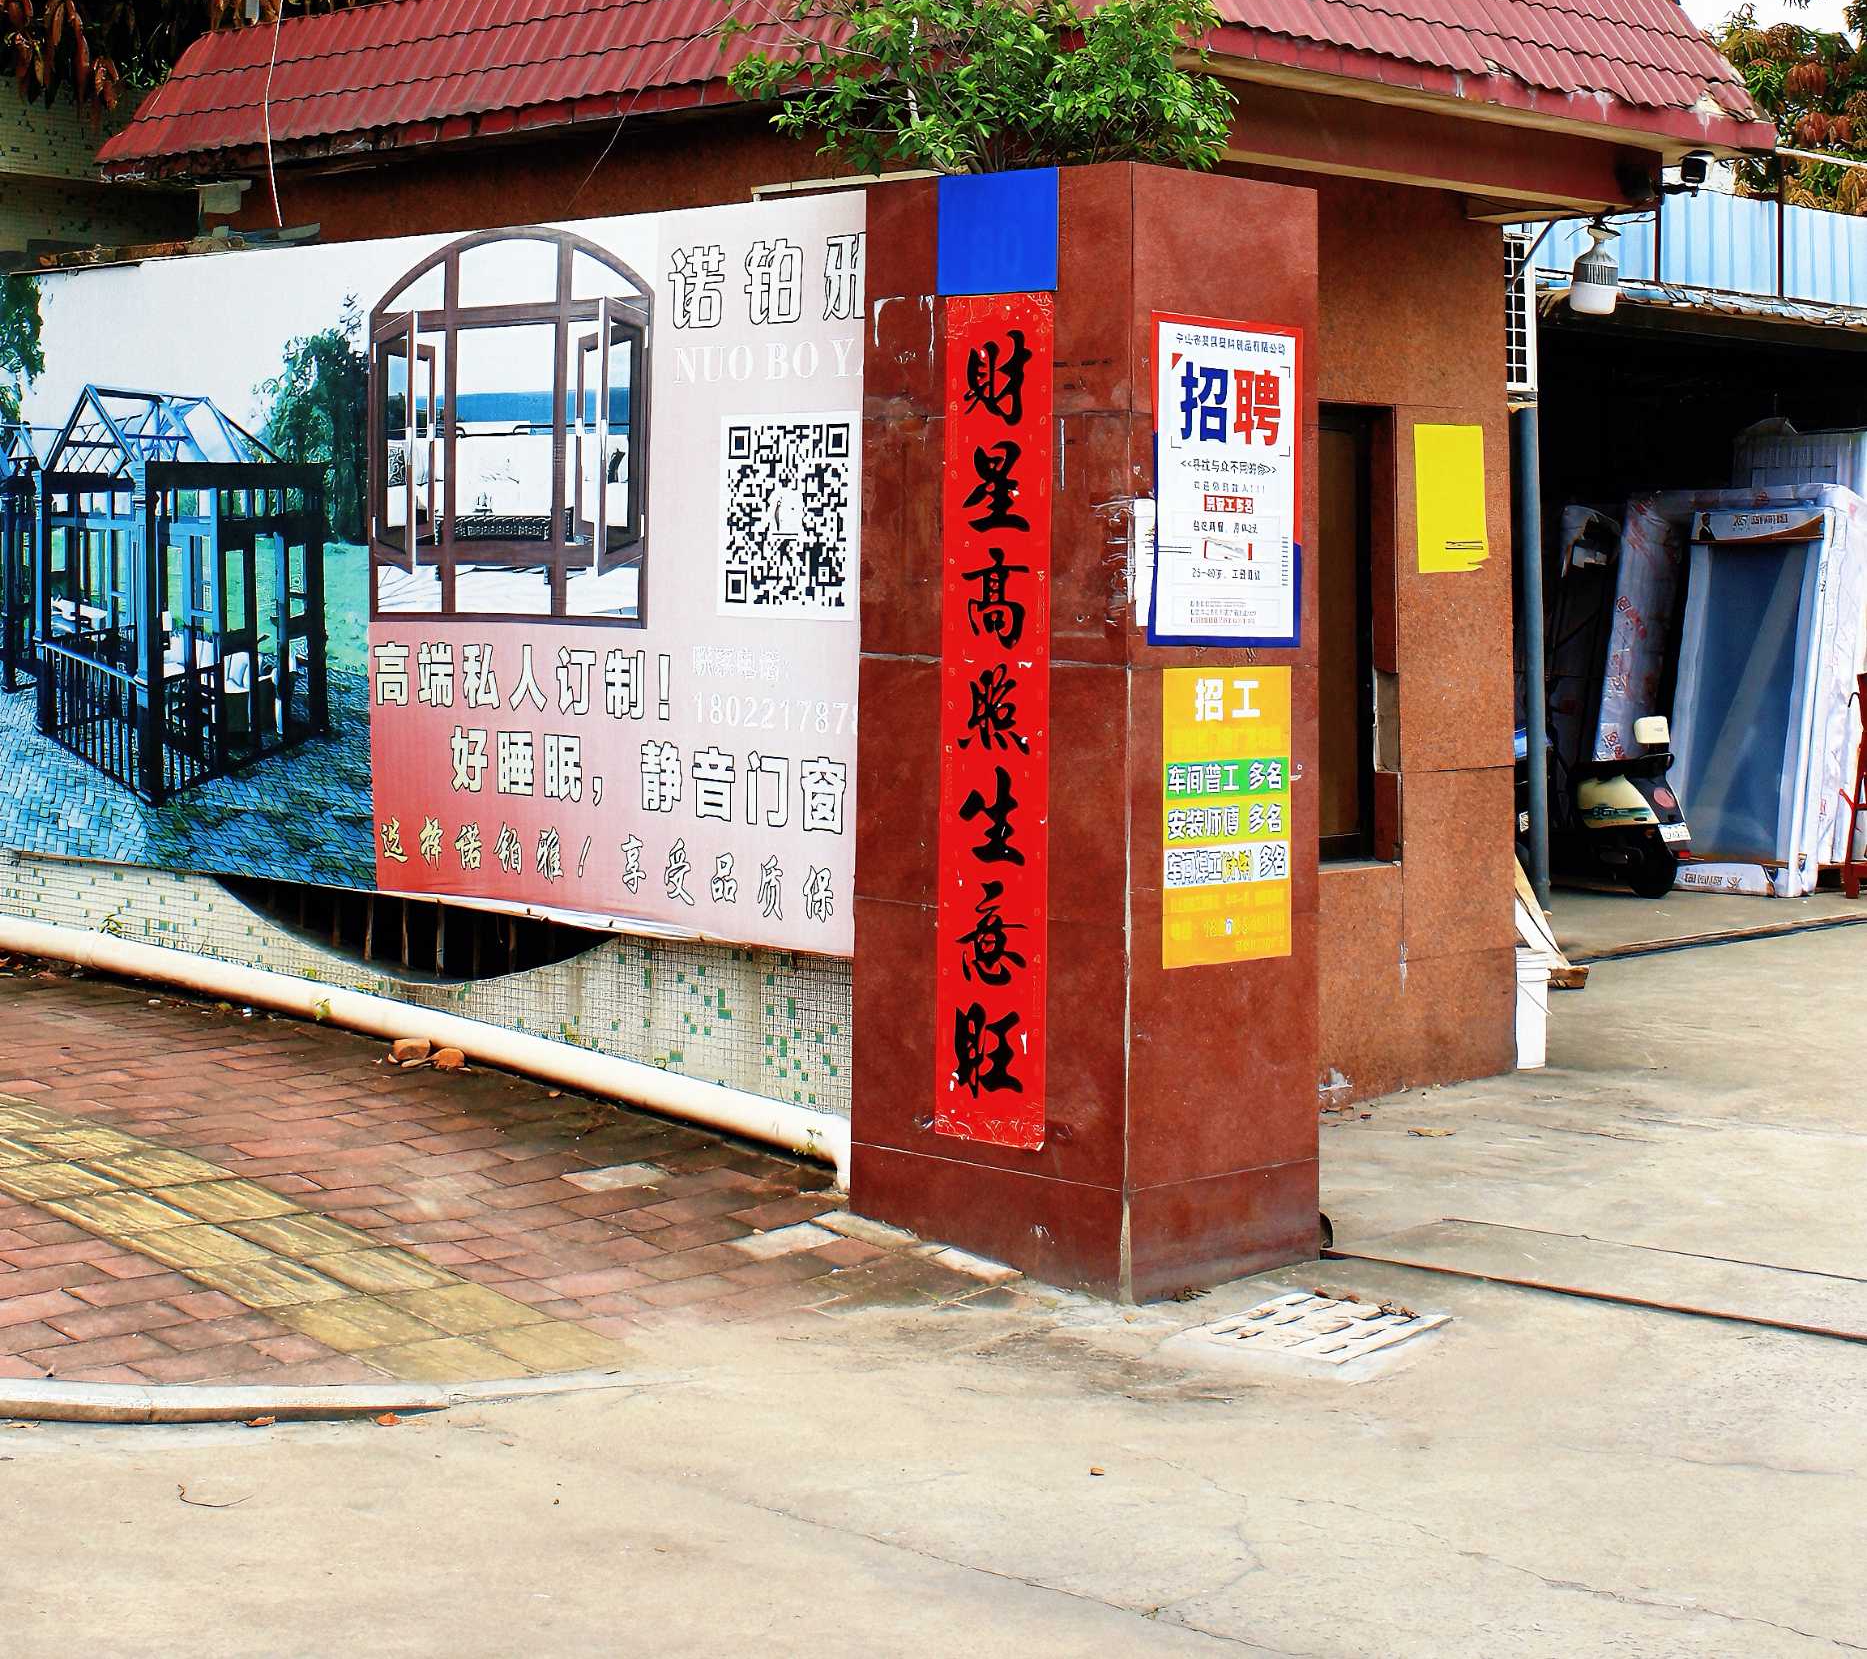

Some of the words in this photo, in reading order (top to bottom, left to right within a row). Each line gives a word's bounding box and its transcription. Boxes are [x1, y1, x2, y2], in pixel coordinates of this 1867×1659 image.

[673, 345, 754, 384] NUO
[765, 340, 819, 380] BO
[830, 338, 864, 377] Y
[1180, 361, 1281, 446] 招聘
[1194, 678, 1262, 722] 招工
[1167, 763, 1240, 795] 车间普工
[1248, 760, 1283, 790] 多名
[1167, 804, 1240, 840] 安装师傅
[1248, 803, 1283, 835] 多名
